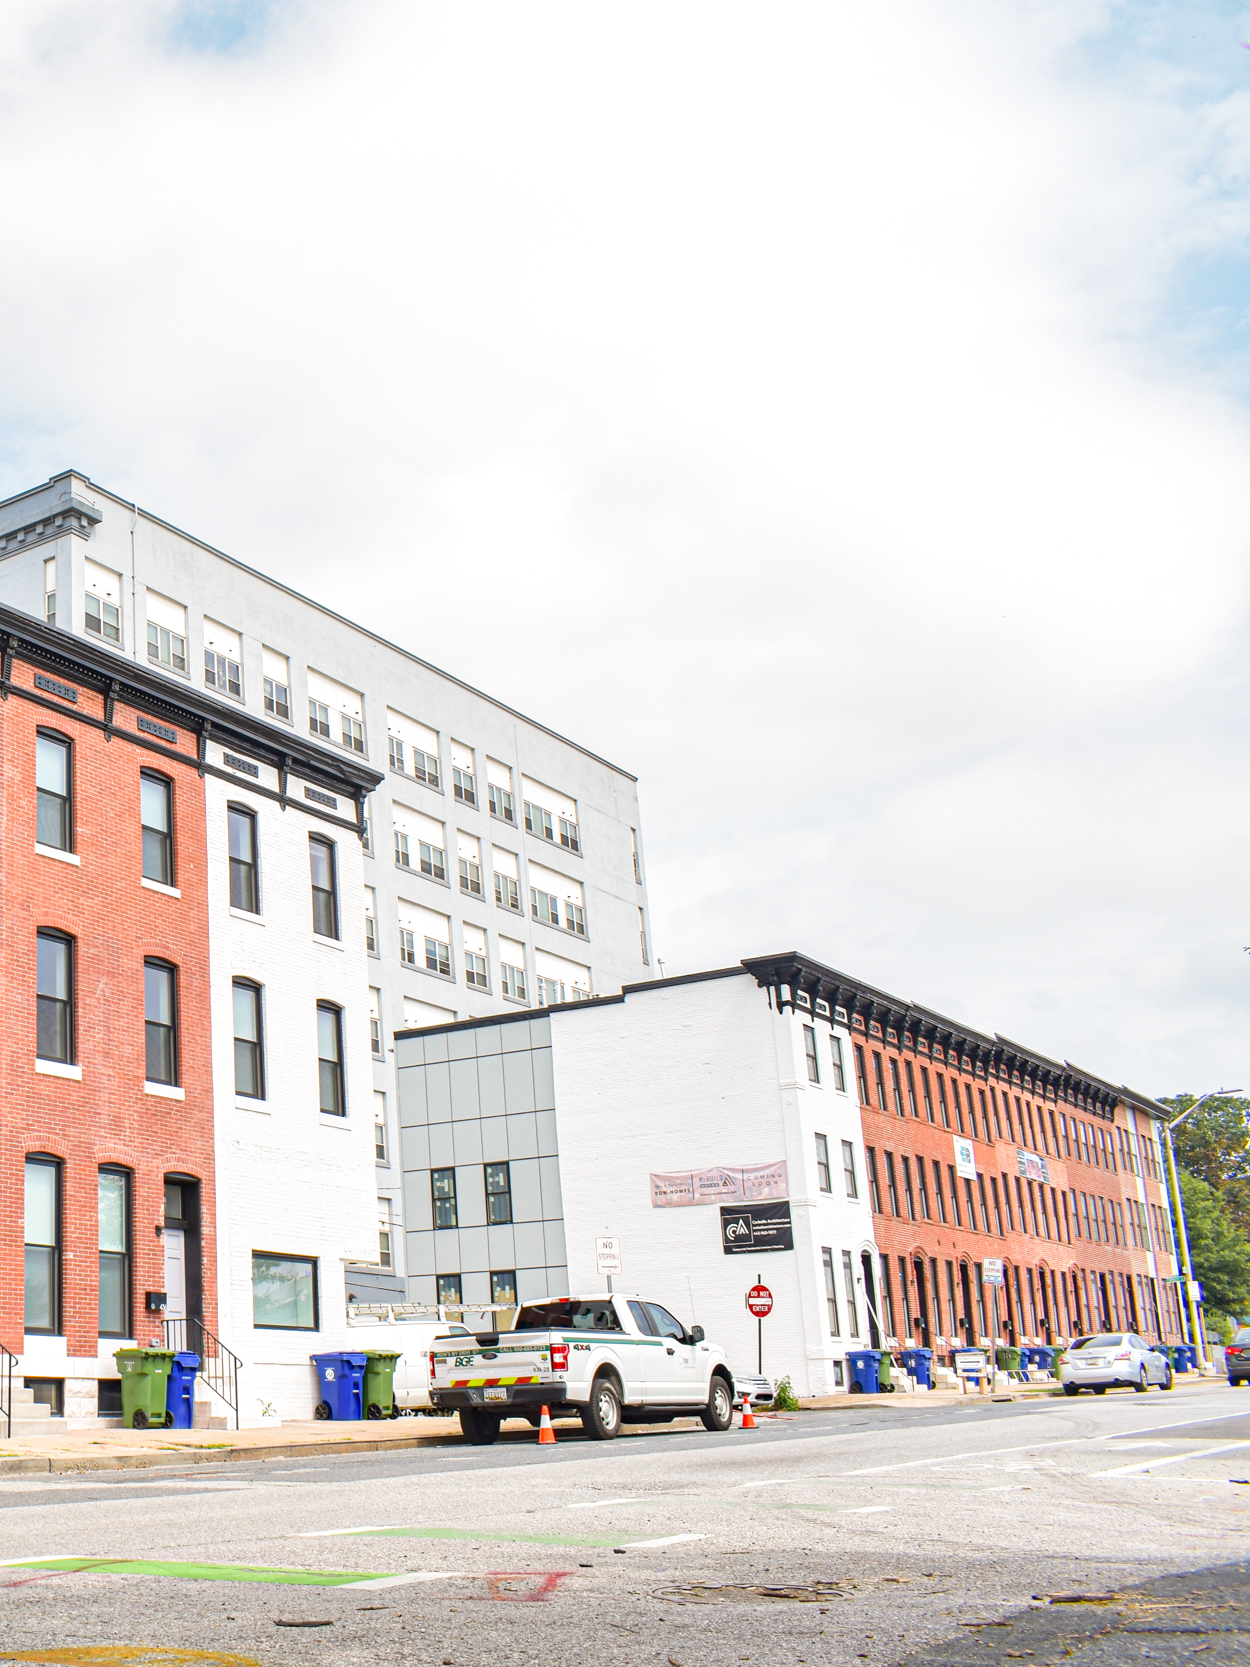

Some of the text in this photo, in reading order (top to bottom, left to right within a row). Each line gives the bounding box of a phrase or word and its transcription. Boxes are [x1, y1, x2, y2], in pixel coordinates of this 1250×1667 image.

[747, 1172, 782, 1181] COMING
[603, 1241, 613, 1249] NO
[454, 1356, 475, 1367] BGE
